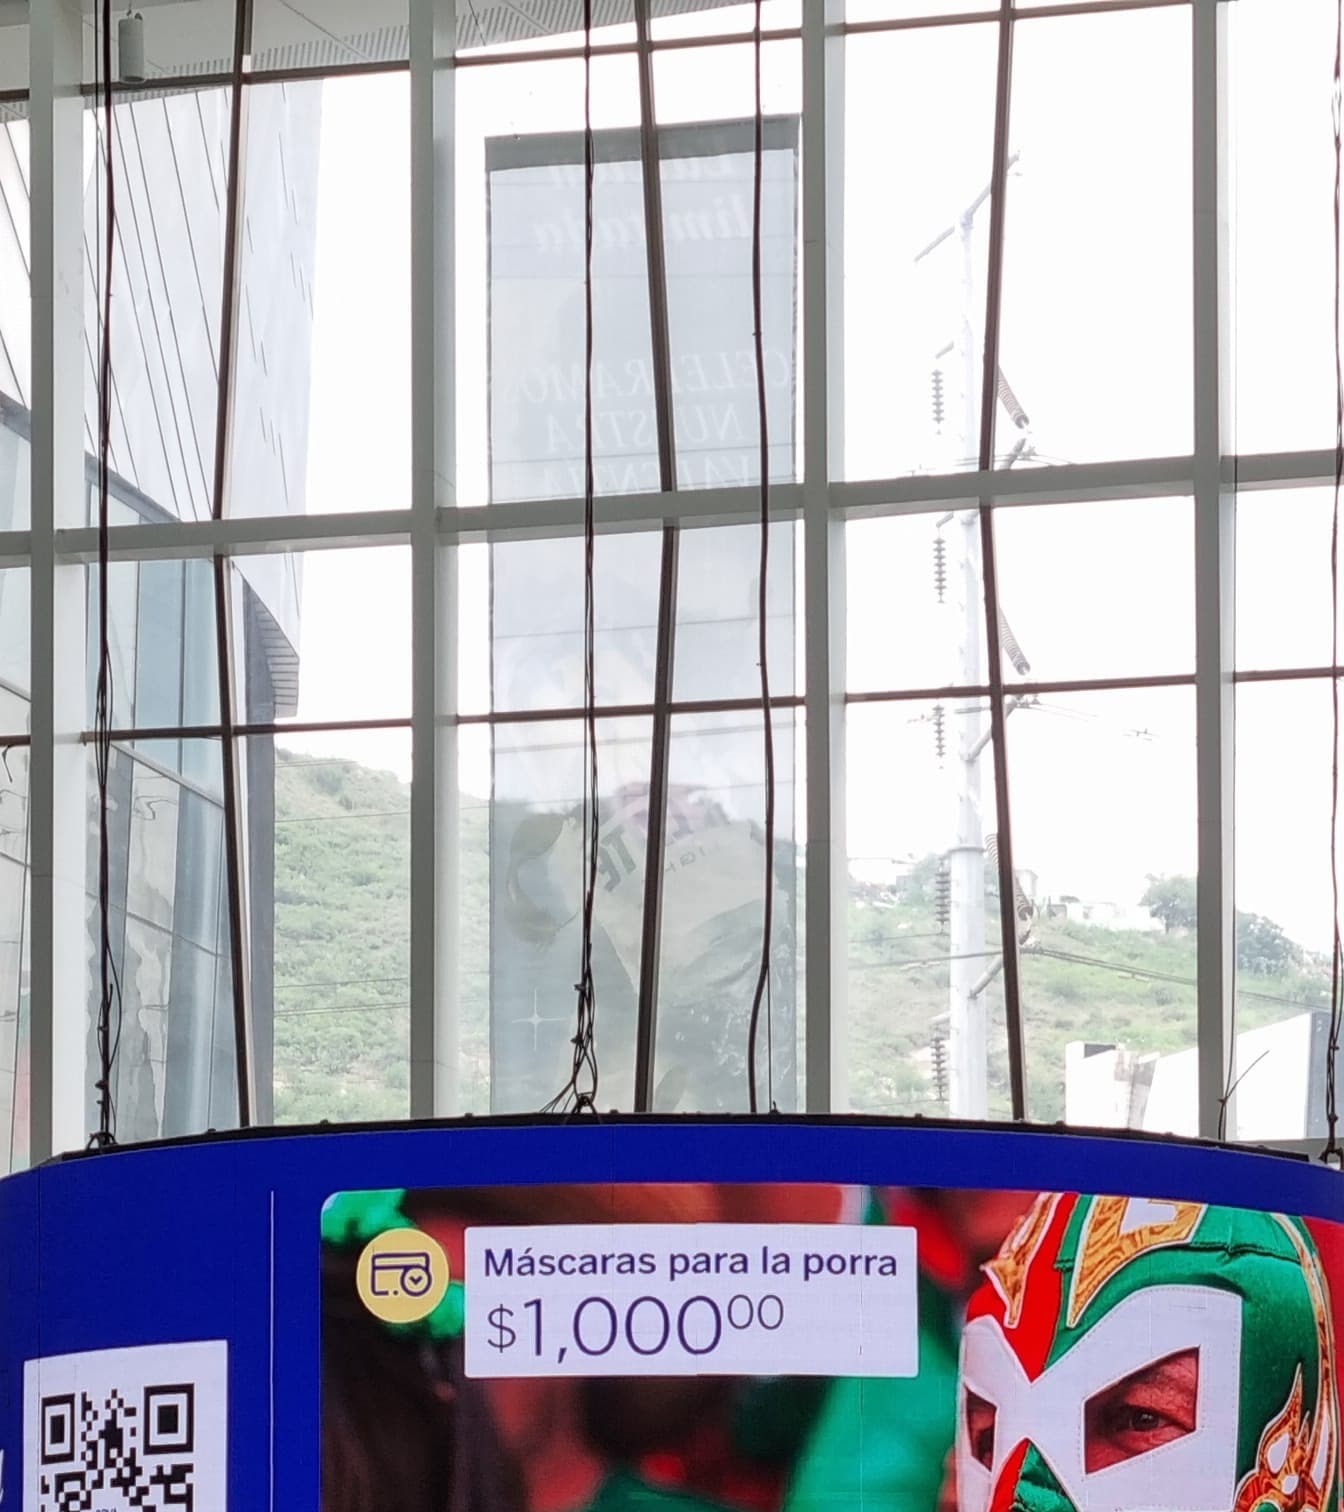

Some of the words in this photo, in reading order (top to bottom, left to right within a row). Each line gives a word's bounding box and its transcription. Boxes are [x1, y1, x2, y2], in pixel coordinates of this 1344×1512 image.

[484, 1246, 657, 1278] Máscaras
[669, 1251, 750, 1282] para
[762, 1246, 791, 1276] la
[803, 1252, 899, 1282] porra
